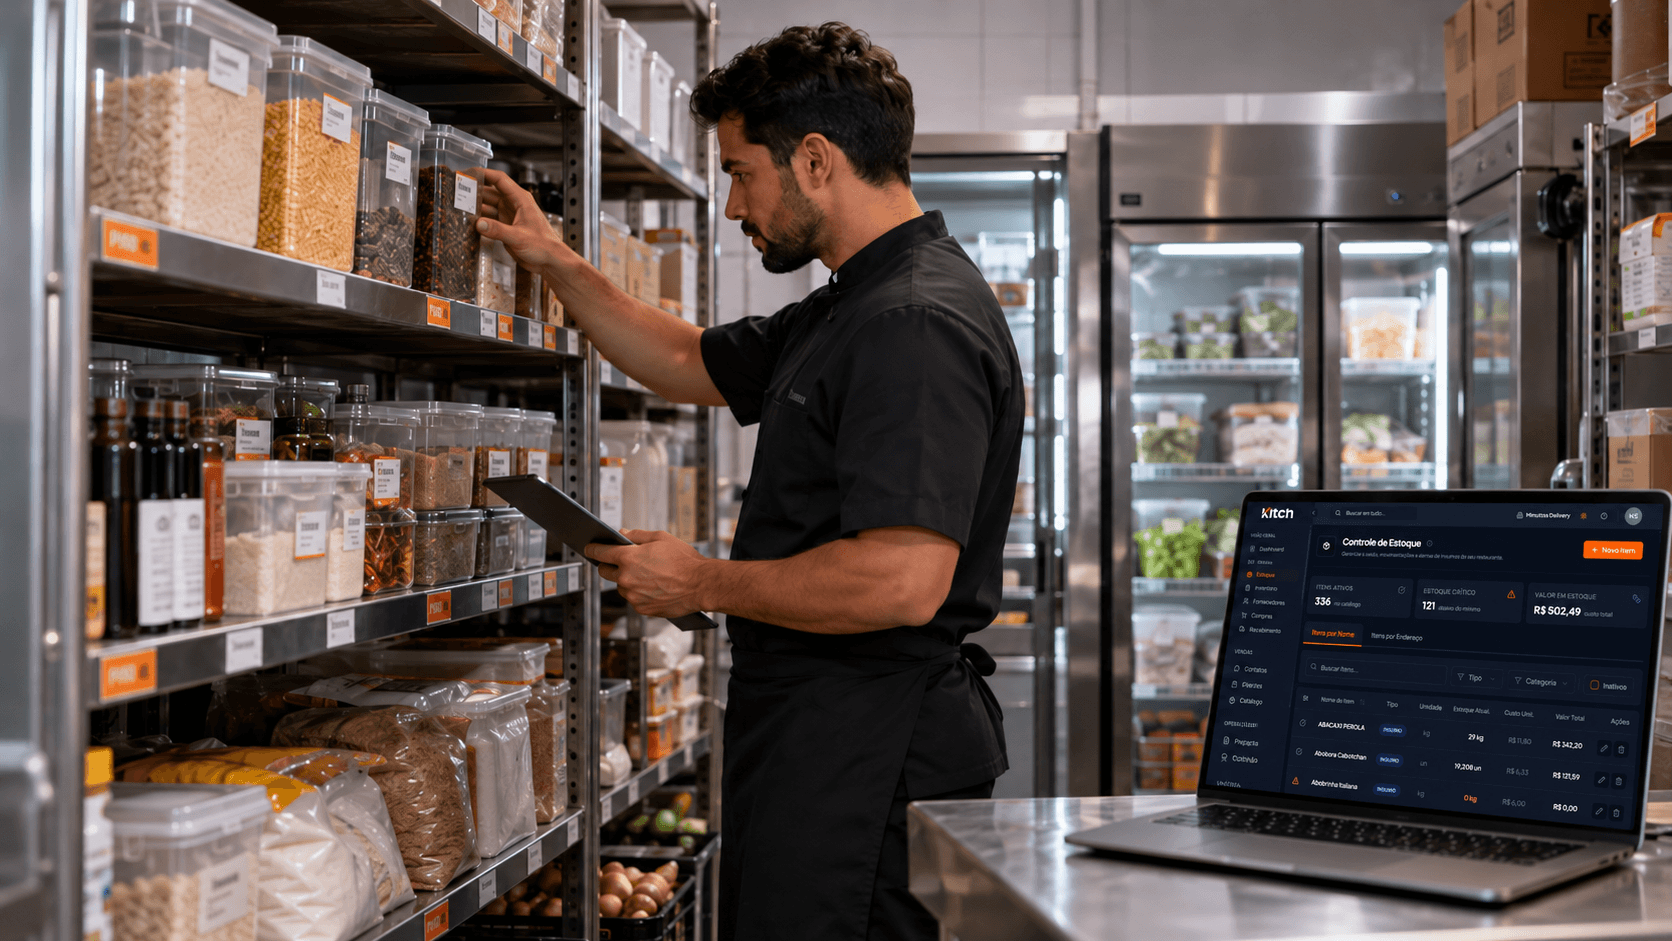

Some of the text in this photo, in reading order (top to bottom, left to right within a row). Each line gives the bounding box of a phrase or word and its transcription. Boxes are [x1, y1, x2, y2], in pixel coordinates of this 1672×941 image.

[1261, 506, 1294, 518] Kitch
[1342, 538, 1422, 549] Controle de Estoque
[1314, 596, 1331, 606] 336
[1422, 601, 1435, 610] 121
[1534, 605, 1546, 615] R$
[1548, 606, 1582, 617] 502,49
[1396, 634, 1423, 642] Endereço
[1468, 674, 1482, 682] Tipo
[1525, 677, 1557, 687] Categoria
[1610, 718, 1630, 726] Ações
[1476, 734, 1484, 742] kg
[1562, 741, 1583, 749] 342,20
[1338, 752, 1367, 761] Cabotchan
[1515, 768, 1529, 776] 6,33
[1562, 772, 1580, 781] 121,59
[1311, 779, 1338, 788] Abobrinha
[1562, 804, 1578, 812] 0,00
